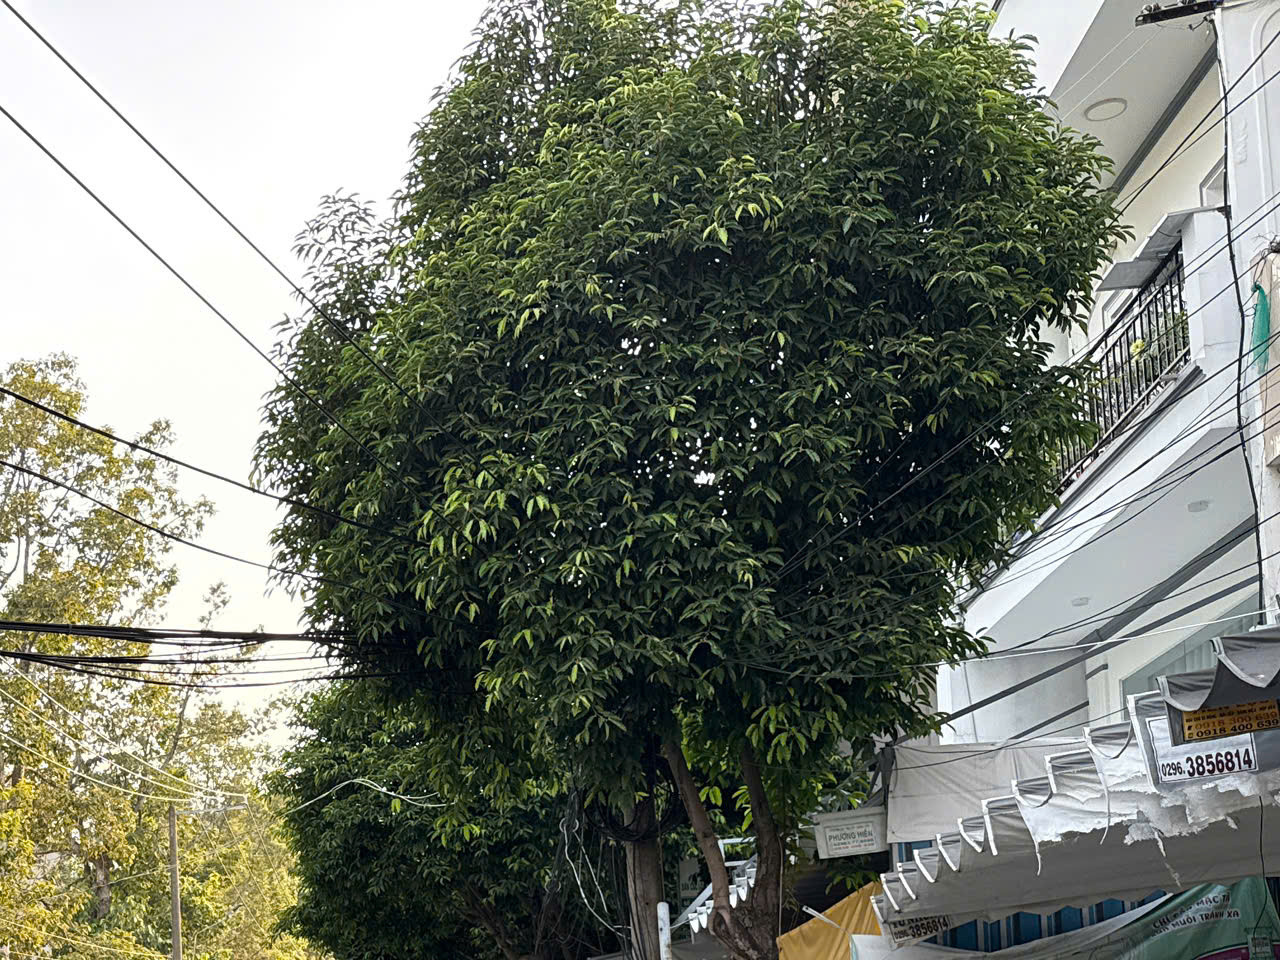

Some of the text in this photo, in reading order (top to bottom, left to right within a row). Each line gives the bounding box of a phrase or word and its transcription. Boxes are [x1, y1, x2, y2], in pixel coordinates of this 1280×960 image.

[1196, 718, 1279, 738] 0918 400 639
[1226, 910, 1240, 919] XA
